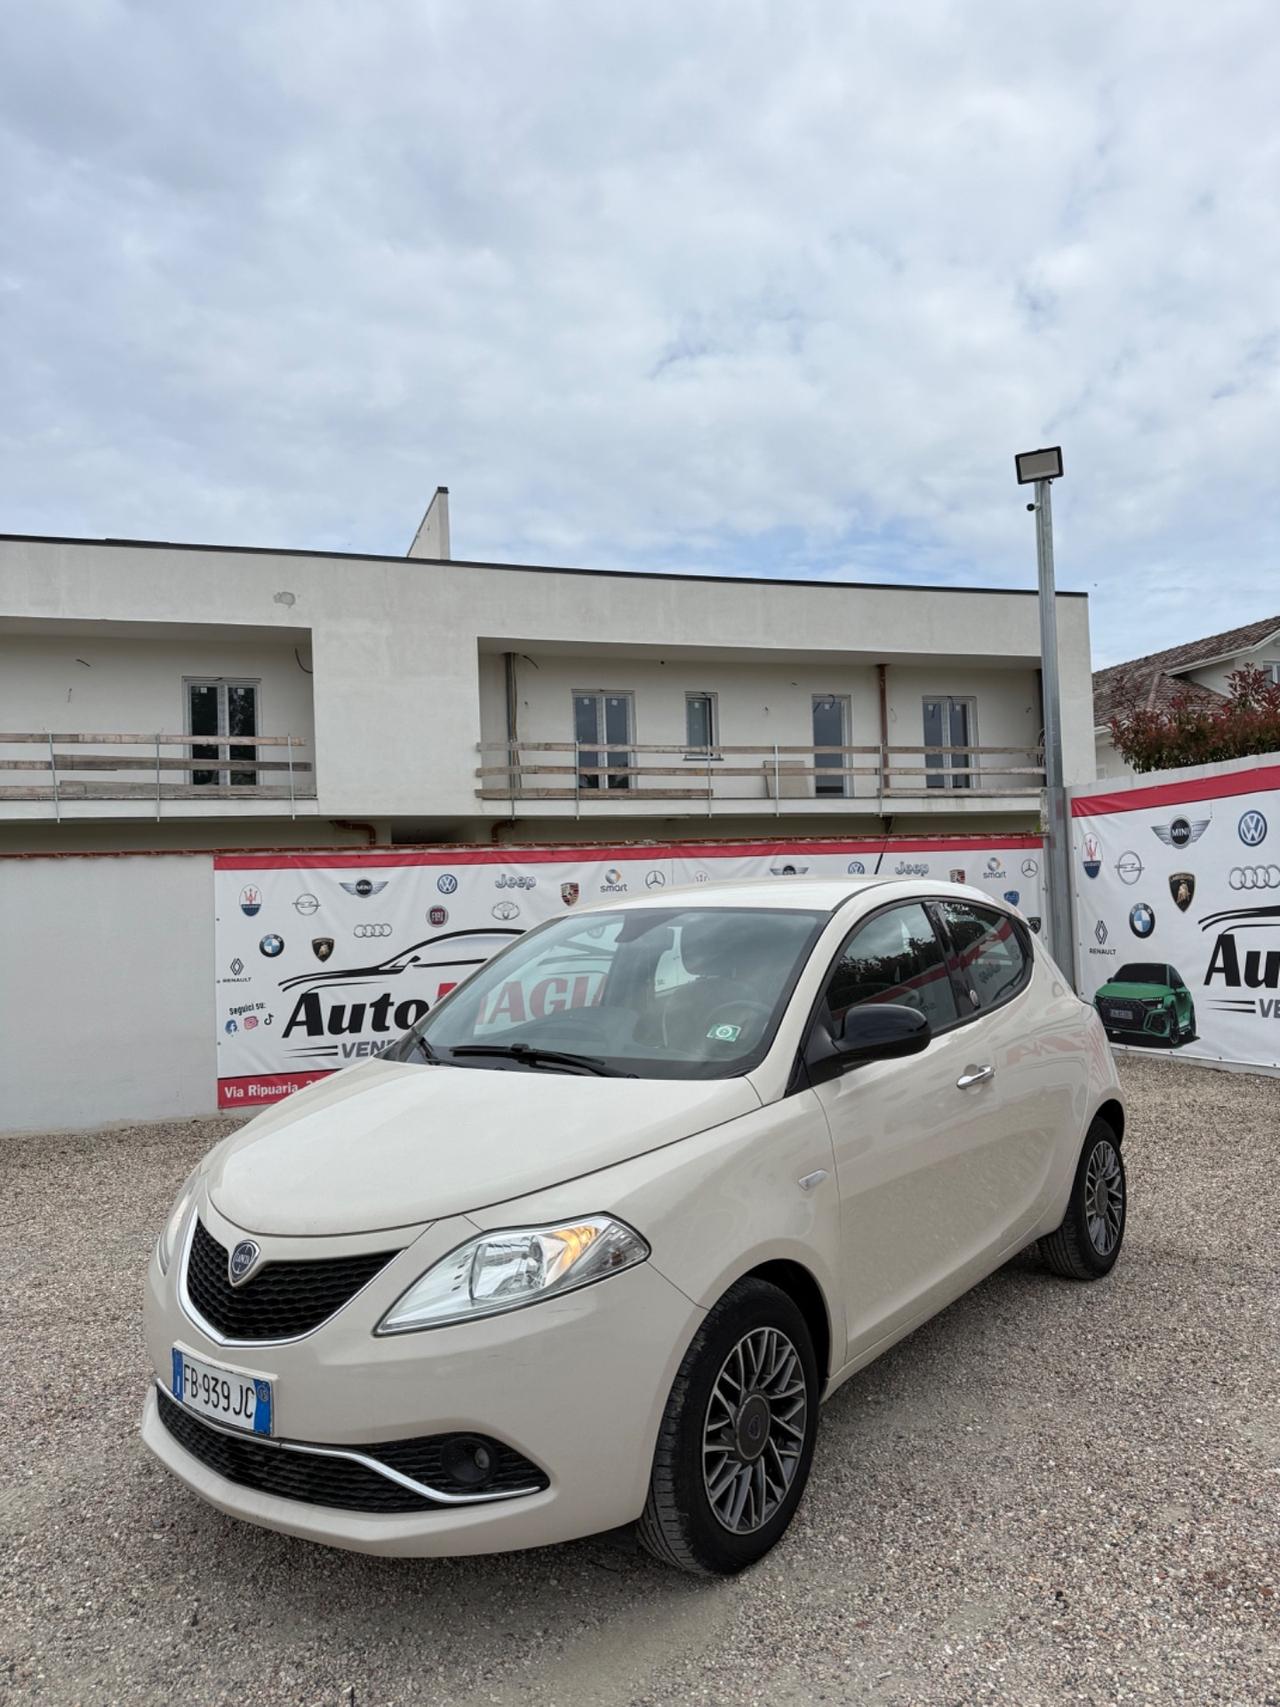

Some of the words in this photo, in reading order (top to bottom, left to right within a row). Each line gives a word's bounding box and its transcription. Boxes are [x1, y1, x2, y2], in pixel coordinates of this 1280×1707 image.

[1171, 828, 1190, 837] MINI
[895, 861, 929, 876] Jeep
[983, 871, 1006, 879] smart
[495, 874, 536, 890] Jeep
[600, 883, 628, 893] smart
[1089, 947, 1116, 955] RENAULT
[229, 1003, 254, 1016] Seguici
[224, 1086, 245, 1098] Via
[248, 1081, 299, 1098] Ripuaria
